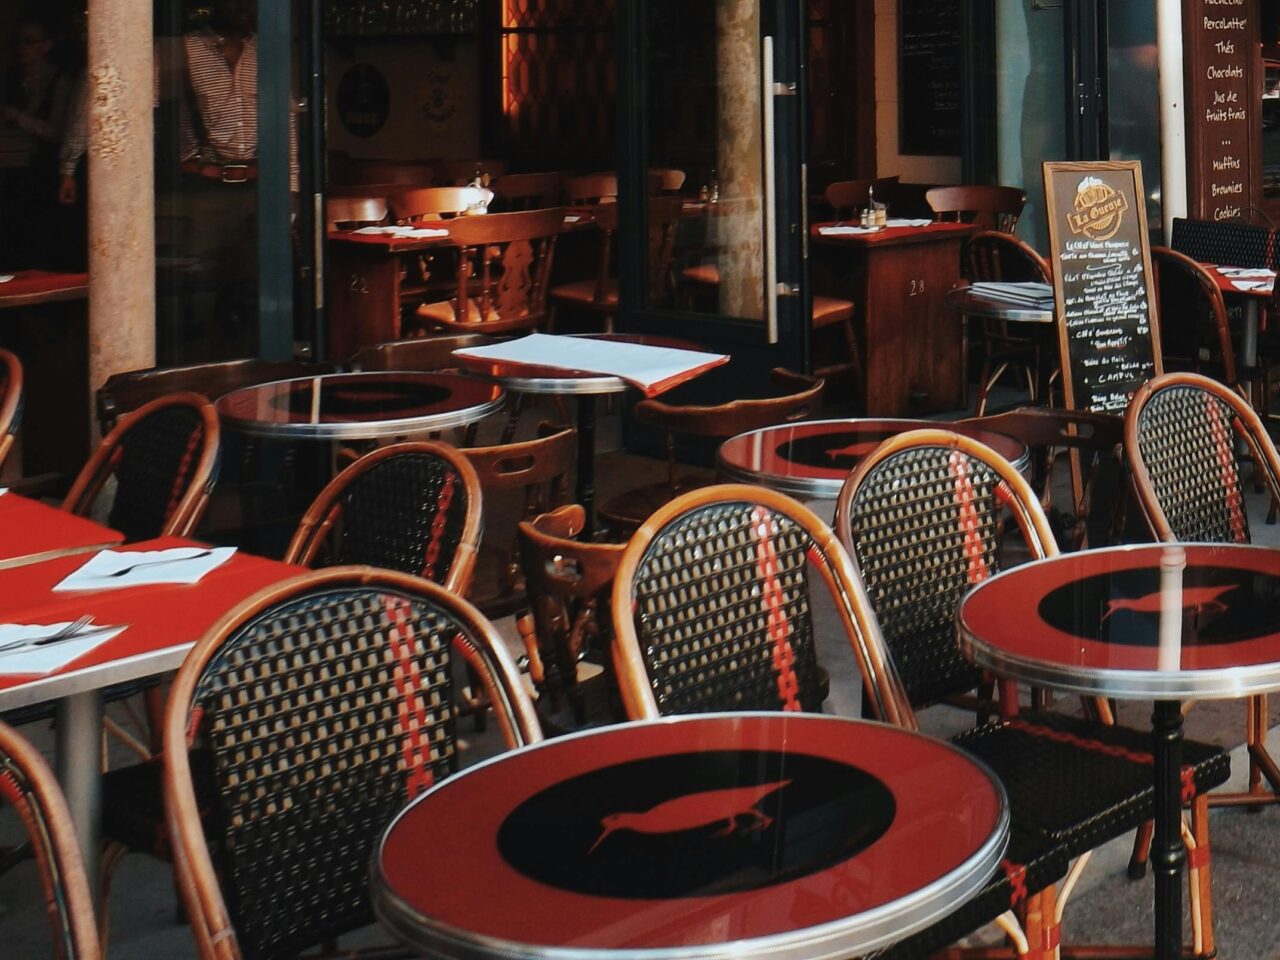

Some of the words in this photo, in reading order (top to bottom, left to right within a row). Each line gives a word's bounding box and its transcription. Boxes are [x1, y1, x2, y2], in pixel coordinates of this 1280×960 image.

[1215, 41, 1234, 55] Thés
[1207, 65, 1243, 79] Chocolats
[1213, 92, 1226, 105] Jus
[1227, 91, 1237, 103] de
[1206, 109, 1227, 122] fruits
[1228, 108, 1246, 121] frais
[1213, 157, 1240, 170] Muffins
[1212, 182, 1242, 197] Brownies
[1073, 214, 1089, 227] La
[1090, 198, 1122, 219] Gueuze
[909, 279, 925, 297] 28
